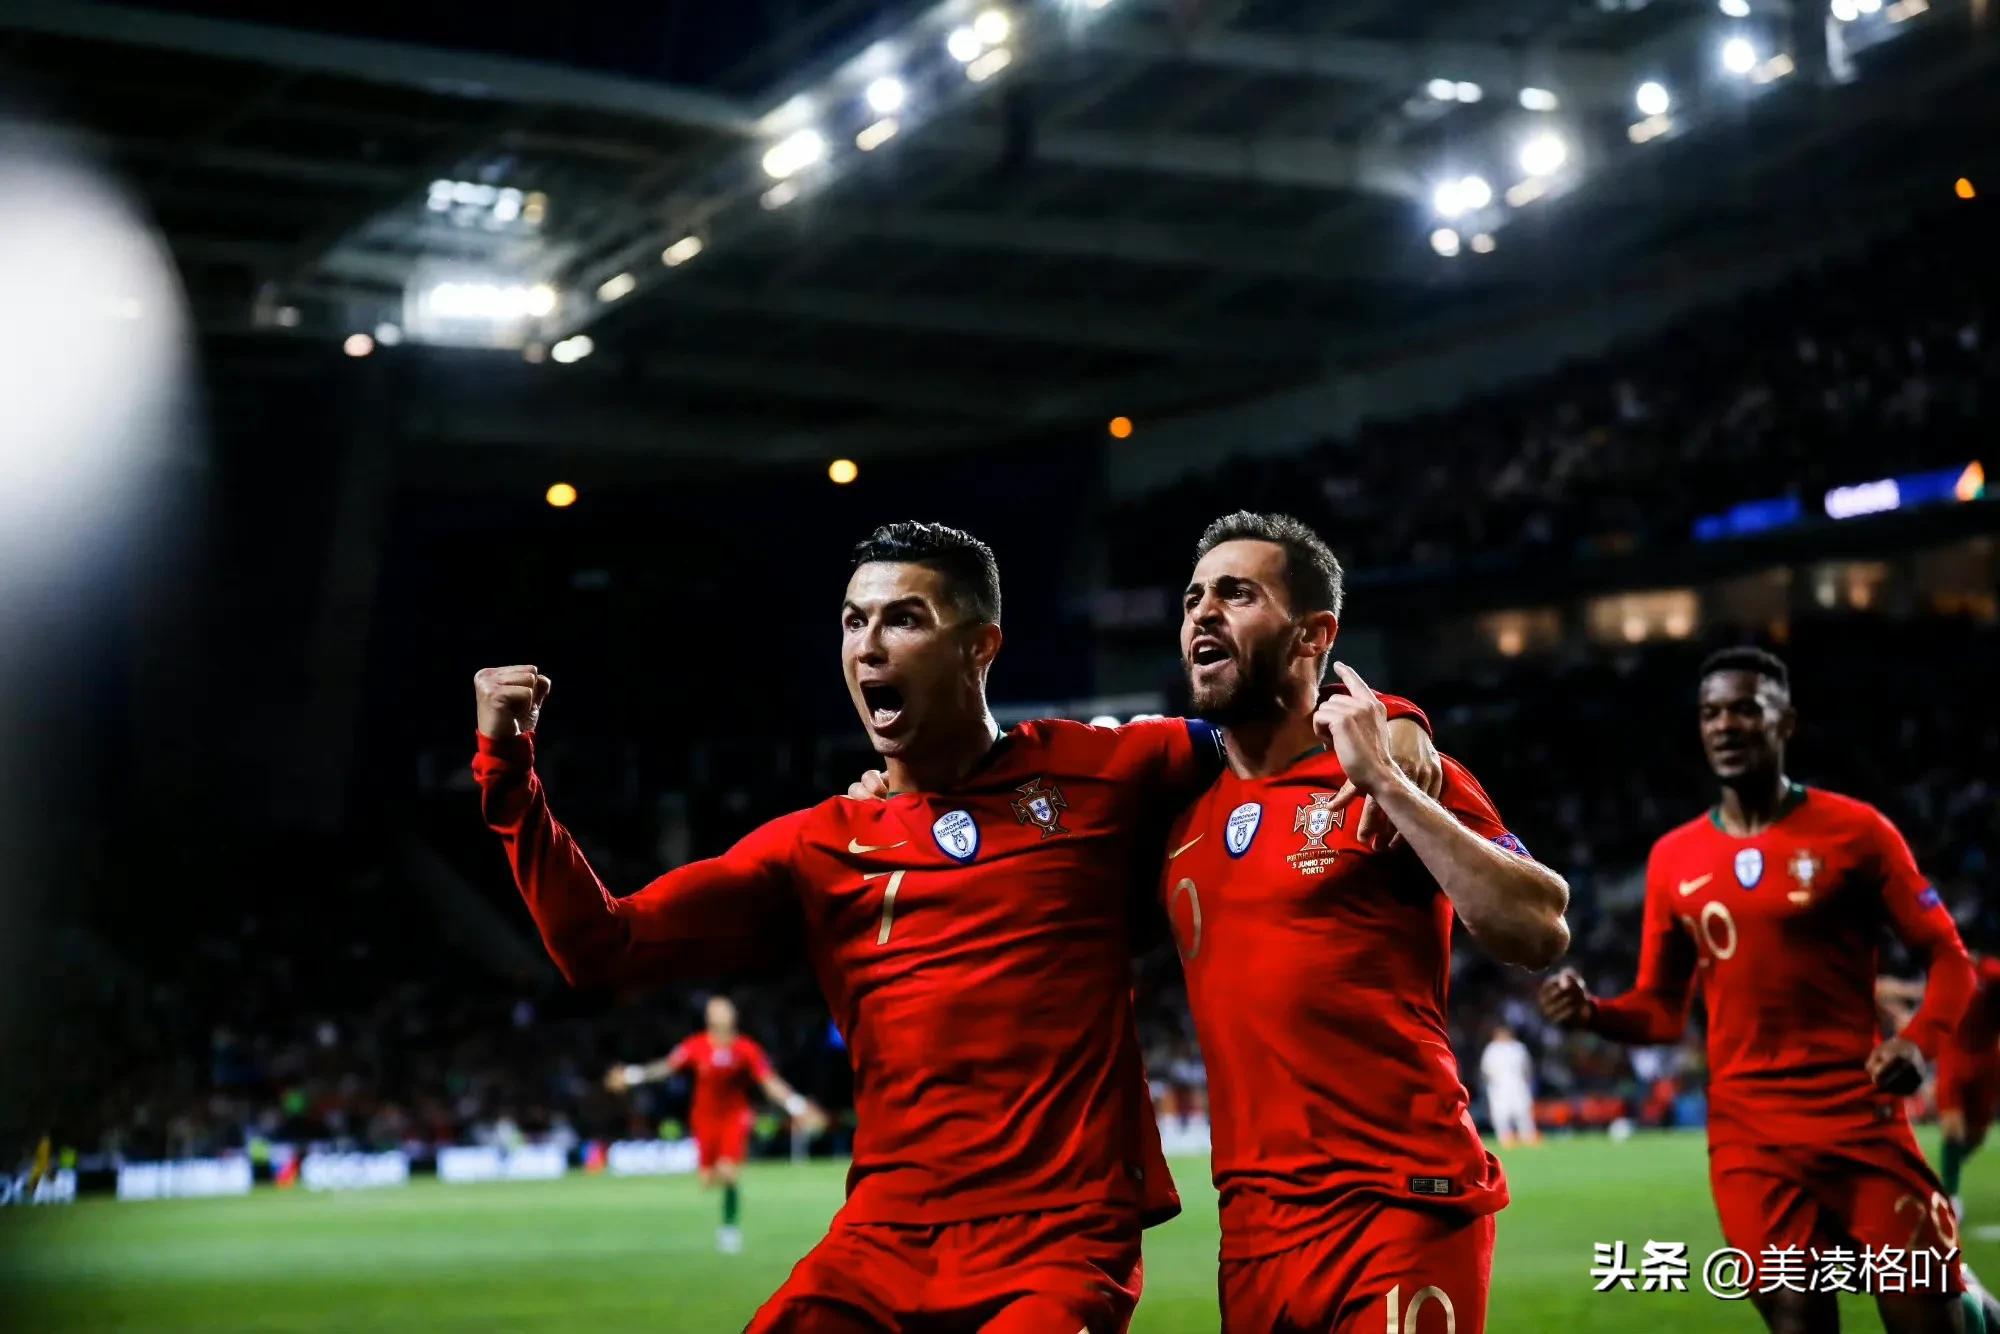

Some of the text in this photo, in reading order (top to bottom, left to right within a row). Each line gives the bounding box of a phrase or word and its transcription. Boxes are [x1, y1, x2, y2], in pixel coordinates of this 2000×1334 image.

[937, 816, 969, 834] EUROPEAN
[1297, 859, 1319, 869] JUNHO
[1319, 857, 1335, 866] 2019
[1302, 866, 1325, 876] PORTO
[863, 870, 906, 946] 7
[1385, 1283, 1456, 1334] 10
